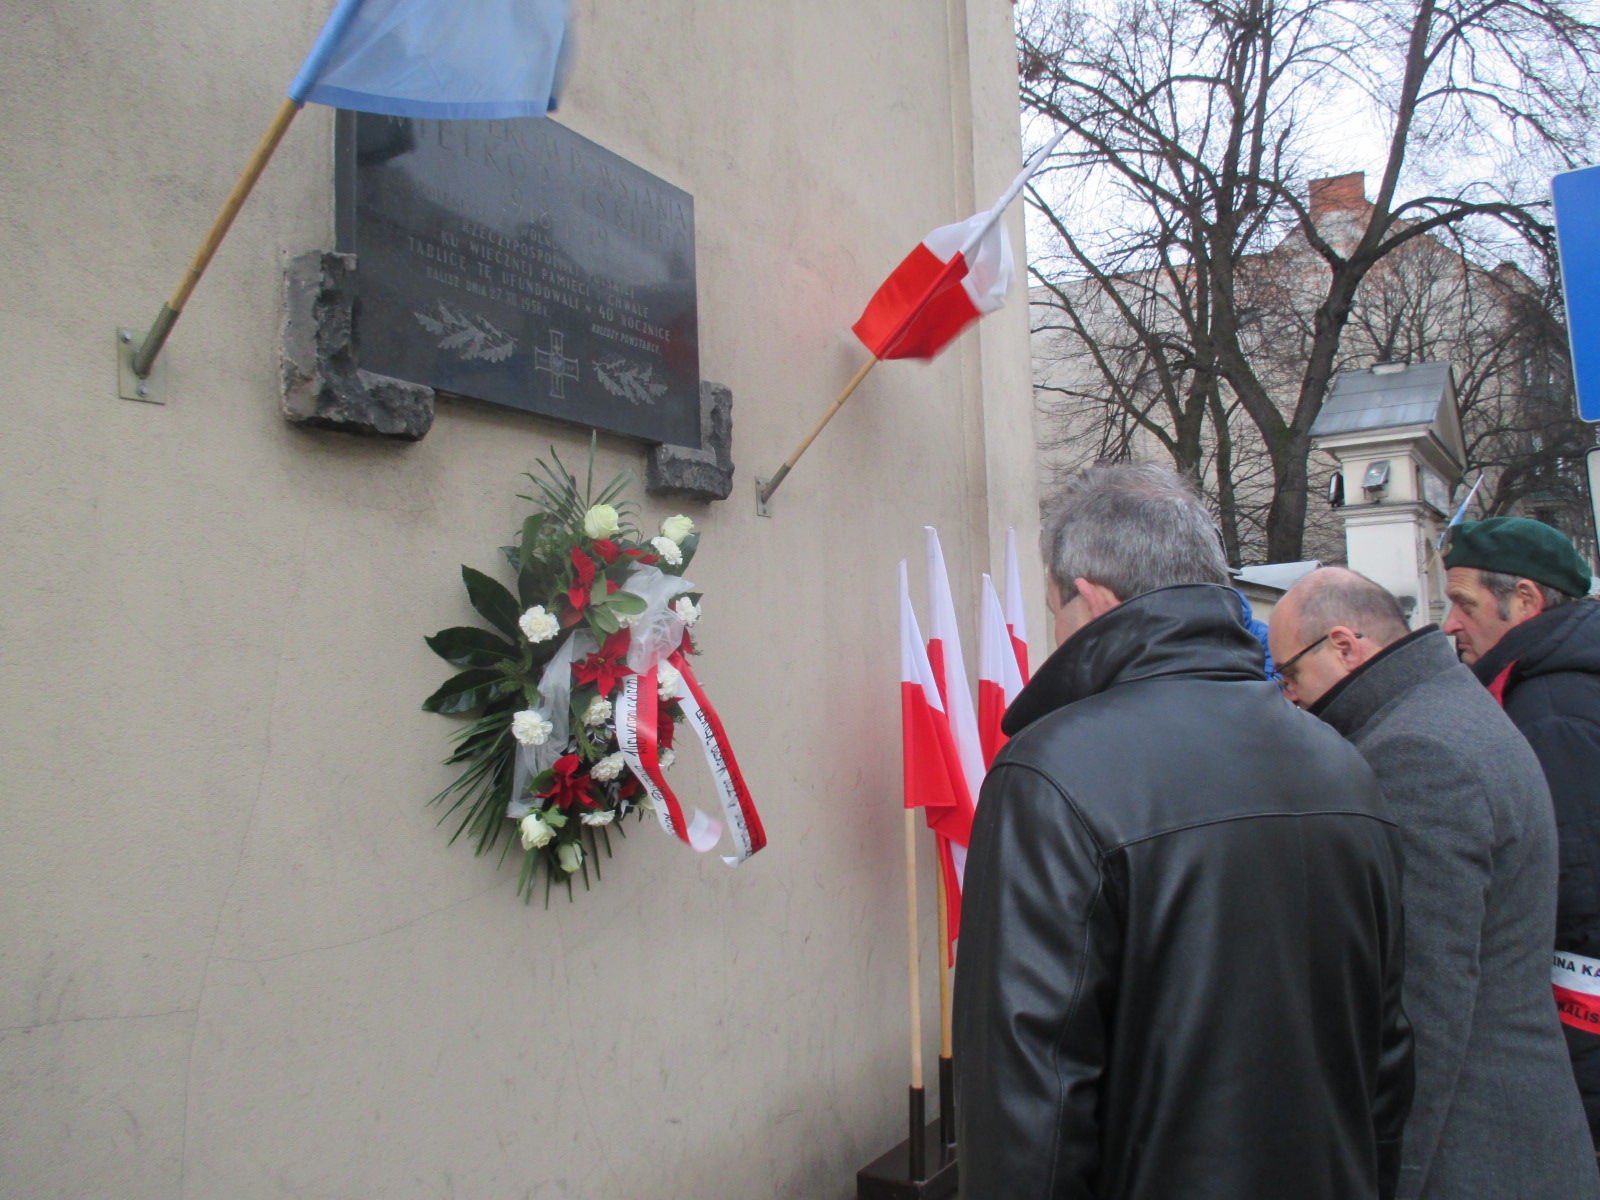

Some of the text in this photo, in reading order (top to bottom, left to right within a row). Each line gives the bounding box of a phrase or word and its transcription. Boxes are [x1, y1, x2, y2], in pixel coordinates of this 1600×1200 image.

[440, 229, 460, 248] KU
[426, 265, 460, 288] KALISZ
[501, 270, 580, 310] UFUNDOWALI
[598, 303, 616, 322] 40
[1558, 1001, 1600, 1024] KALIS
